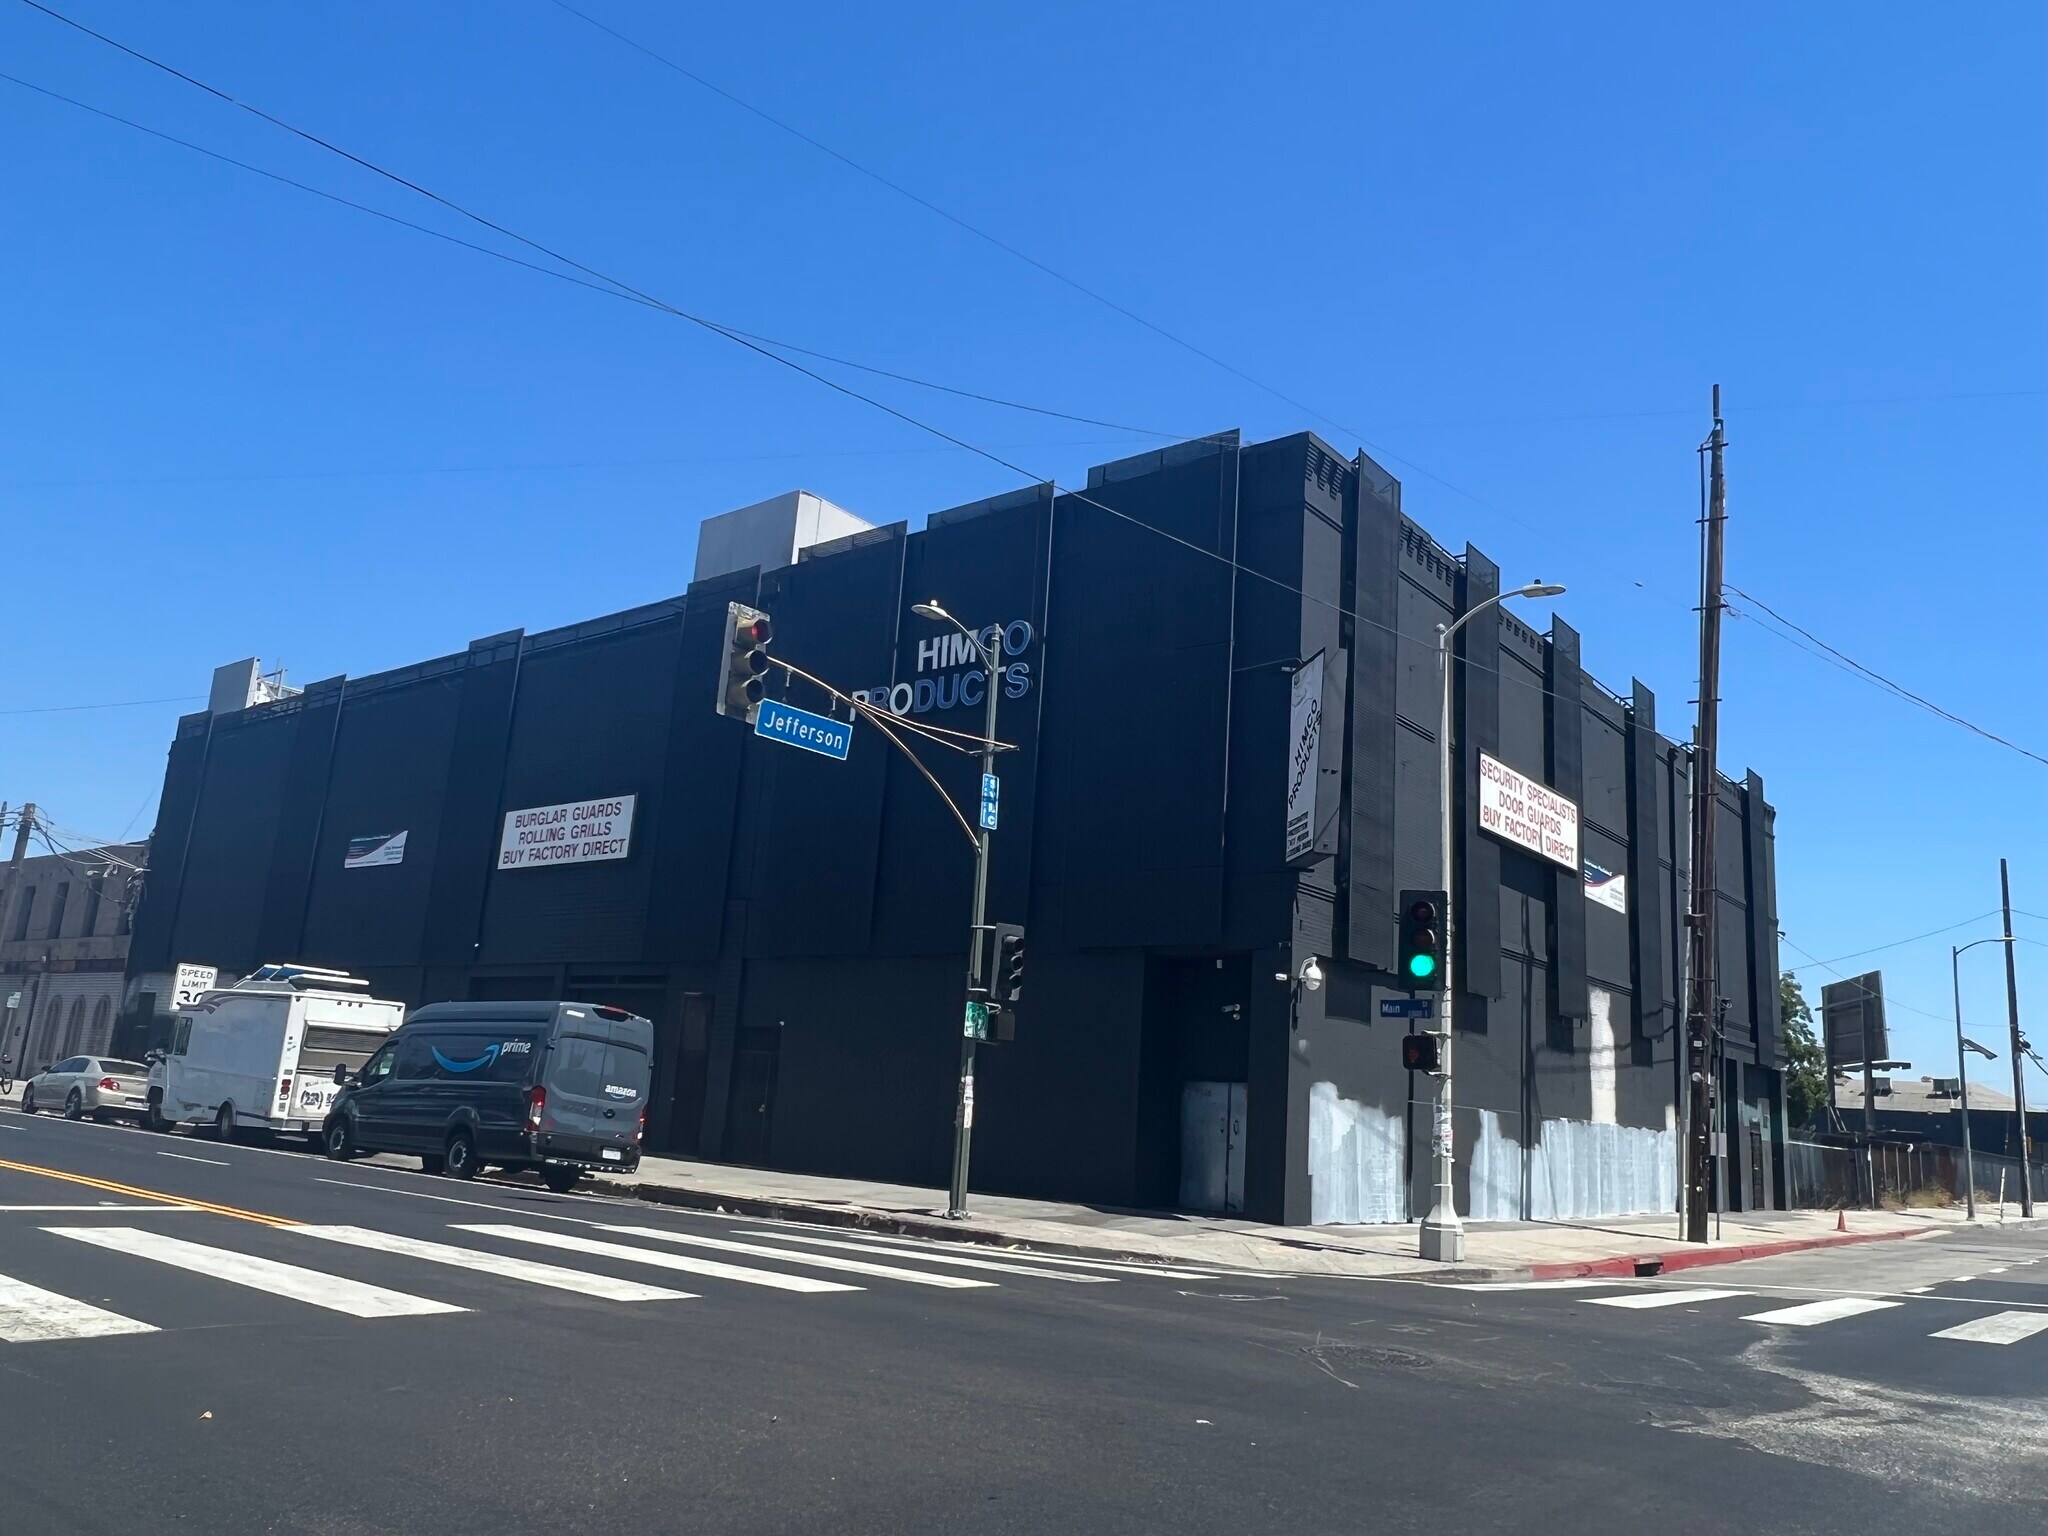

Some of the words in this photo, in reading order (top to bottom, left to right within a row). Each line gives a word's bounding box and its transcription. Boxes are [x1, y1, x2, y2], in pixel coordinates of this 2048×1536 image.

[850, 662, 1030, 722] PRODUCS
[764, 711, 843, 750] Jefferson
[1294, 699, 1317, 766] HIMCO
[1288, 710, 1322, 810] PRODUCTS
[1481, 759, 1524, 795] SECURITY
[1527, 784, 1576, 824] SPECIALISTS
[515, 808, 567, 828] BURGLAR
[572, 801, 622, 820] GUARDS
[1499, 790, 1524, 818] DOOR
[1527, 806, 1562, 836] GUARDS
[518, 826, 565, 845] ROLLING
[570, 821, 612, 839] GRILLS
[1483, 805, 1501, 828] BUY
[1504, 815, 1542, 849] FACTORY
[1545, 835, 1574, 862] DIRECT
[503, 850, 524, 864] BUY
[528, 843, 579, 861] FACTORY
[582, 838, 626, 856] DIRECT
[181, 968, 213, 979] SPEED
[182, 980, 207, 989] LIMIT
[500, 1038, 531, 1056] prime
[604, 1084, 637, 1098] amazon
